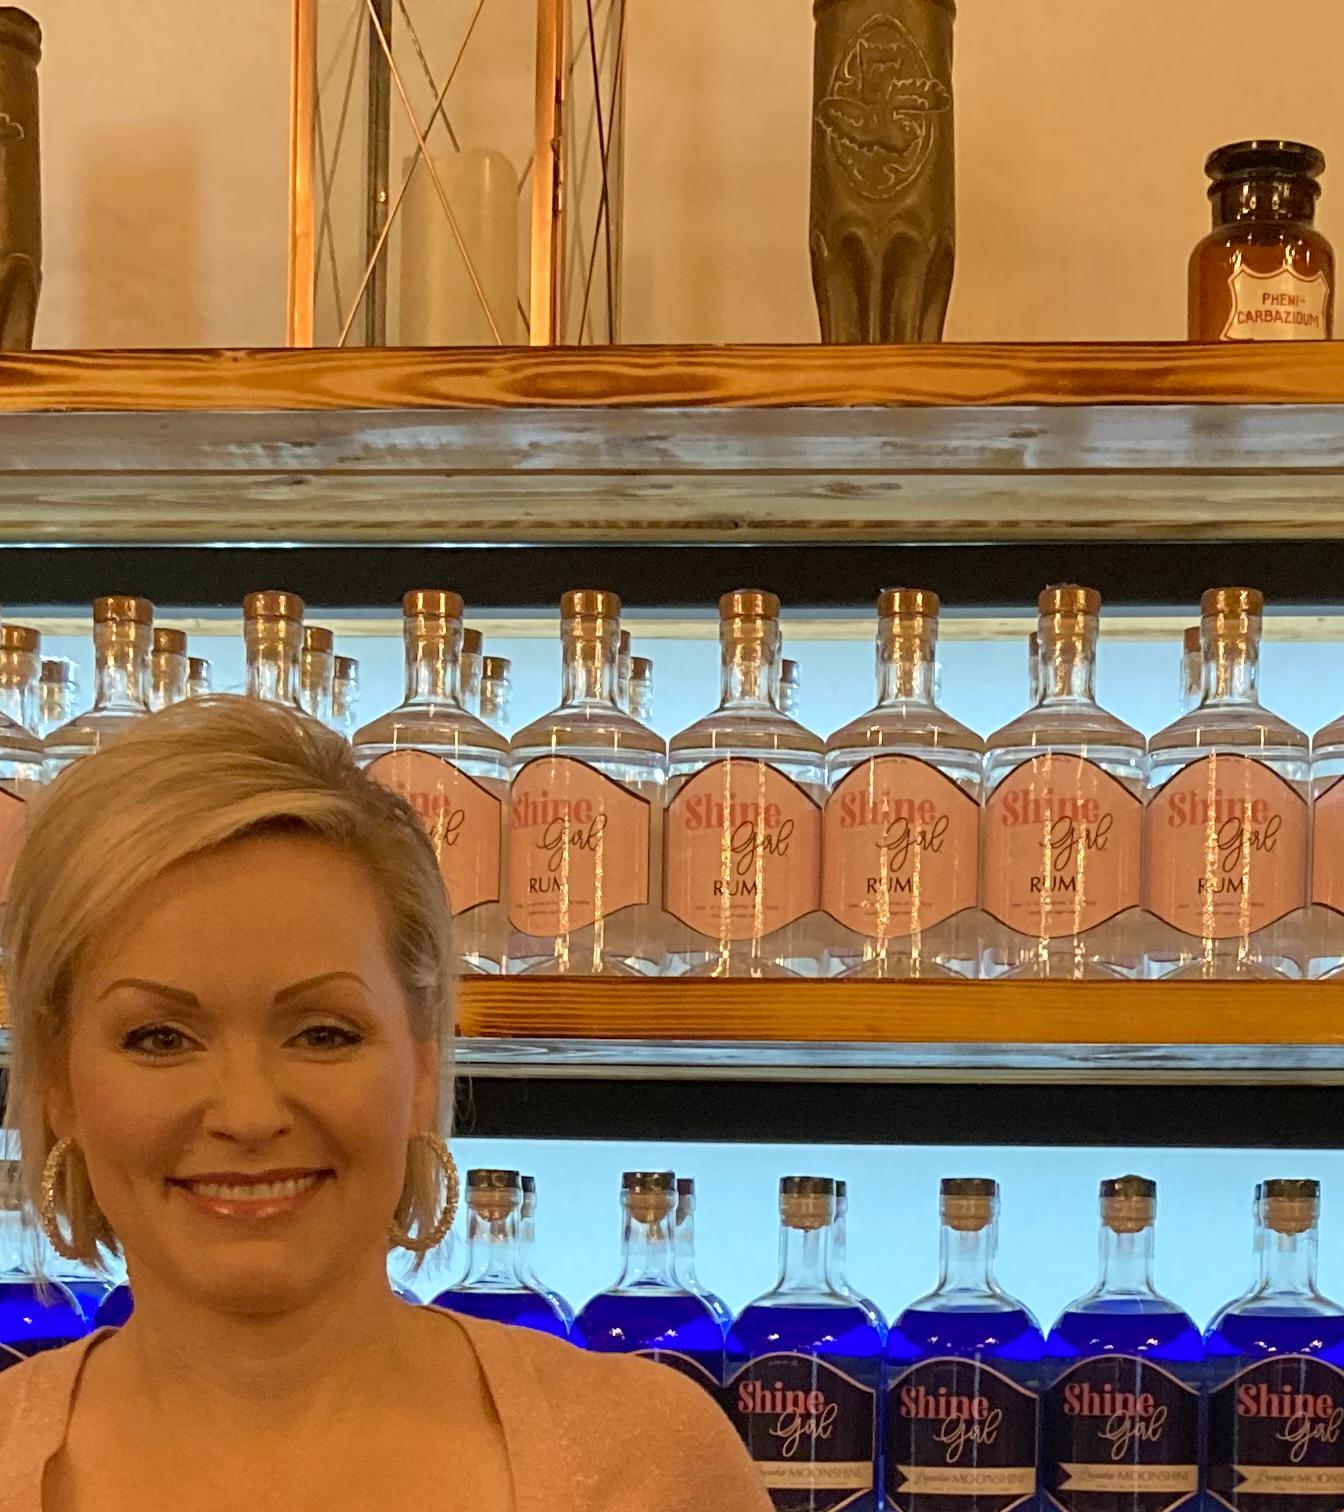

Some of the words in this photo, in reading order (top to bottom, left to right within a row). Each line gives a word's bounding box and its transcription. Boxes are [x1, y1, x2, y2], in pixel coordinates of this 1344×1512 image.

[1237, 311, 1319, 326] CARBAZIDUM
[529, 877, 564, 894] RUM
[713, 879, 758, 898] RUM
[866, 877, 912, 894] RUM
[1030, 875, 1076, 893] RUM
[1198, 877, 1244, 895] RUM
[738, 1381, 825, 1414] Shine
[900, 1386, 989, 1419] Shine
[1064, 1383, 1155, 1417] Shine
[1238, 1385, 1333, 1418] Shine
